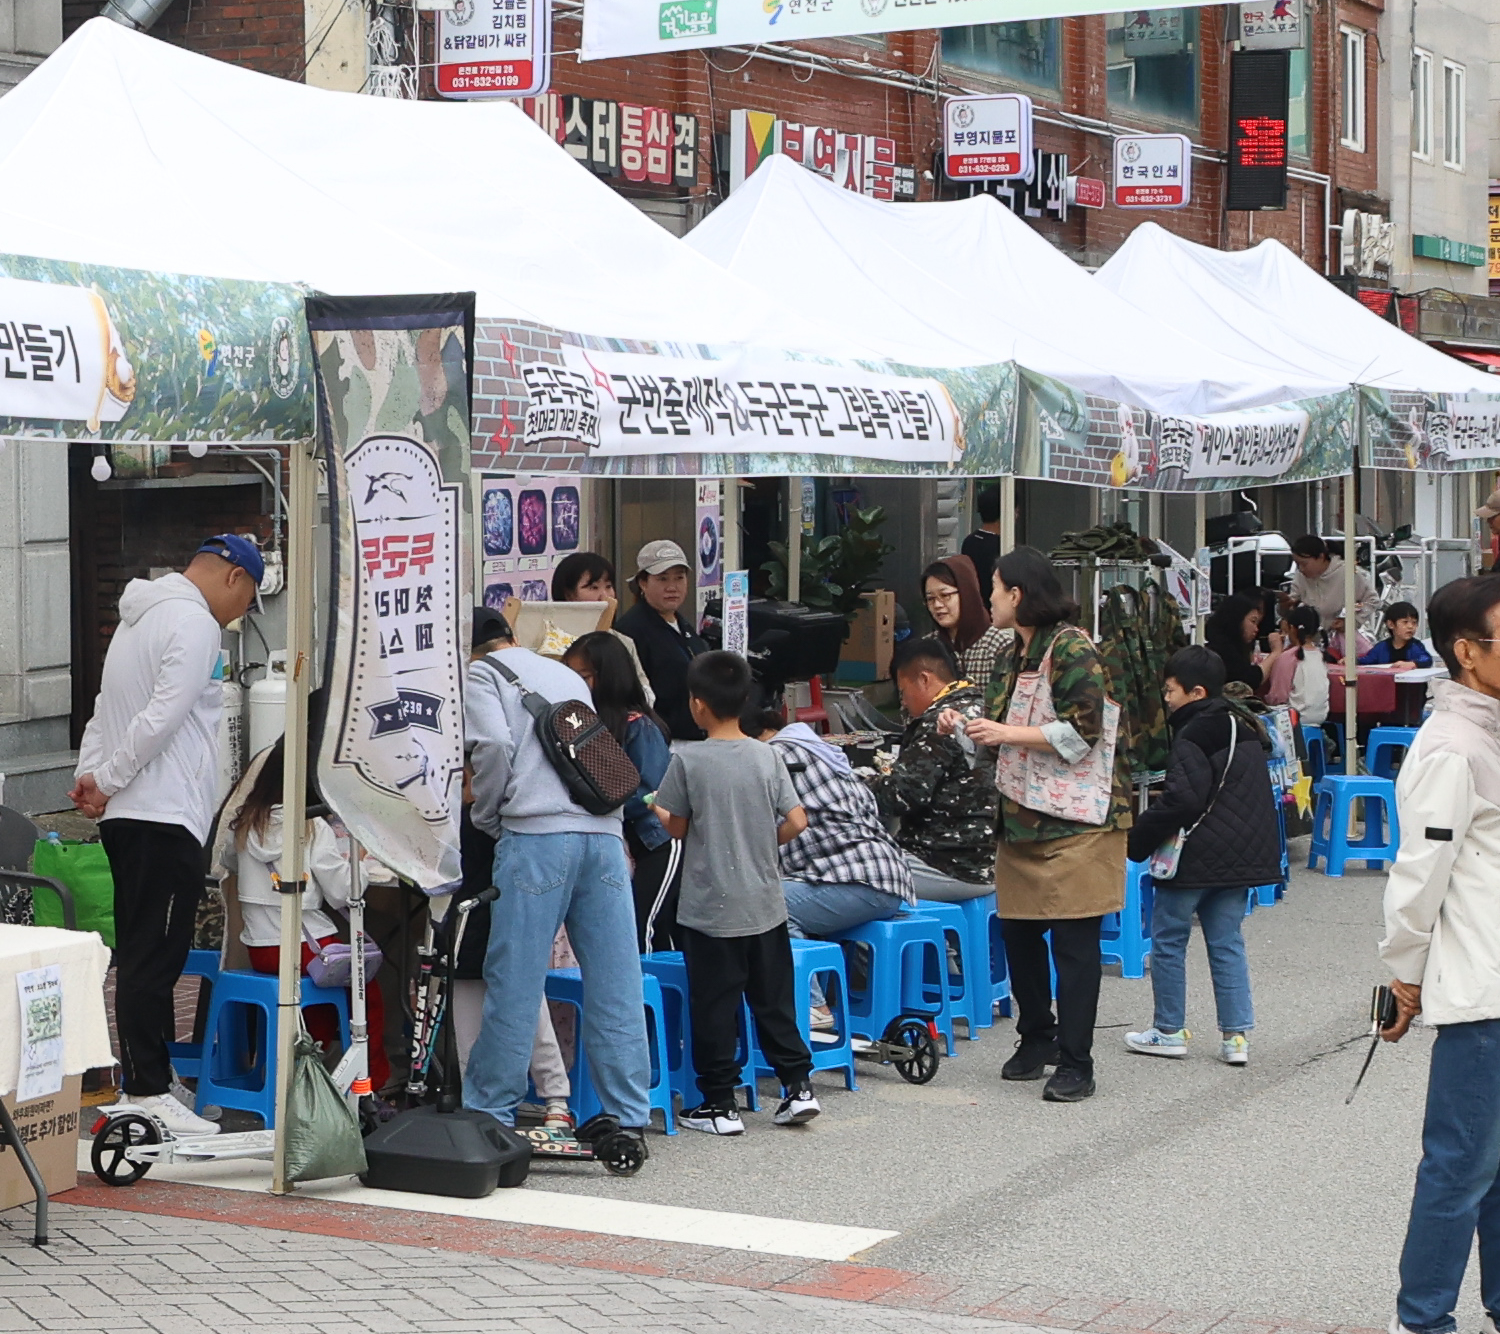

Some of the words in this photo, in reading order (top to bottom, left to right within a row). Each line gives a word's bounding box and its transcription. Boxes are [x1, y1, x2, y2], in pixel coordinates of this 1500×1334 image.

[492, 14, 528, 30] 김치찜
[1243, 11, 1265, 24] 한국
[443, 34, 501, 51] &닭갈비가
[503, 31, 528, 49] 싸닭
[452, 76, 519, 89] 031-832-0199
[516, 91, 697, 179] 마스터통삼겹
[1122, 164, 1179, 179] 한국인쇄
[220, 344, 256, 369] 연천군
[521, 366, 598, 410] 두군두군
[39, 1117, 56, 1141] 추가
[57, 1111, 78, 1136] 할인!
